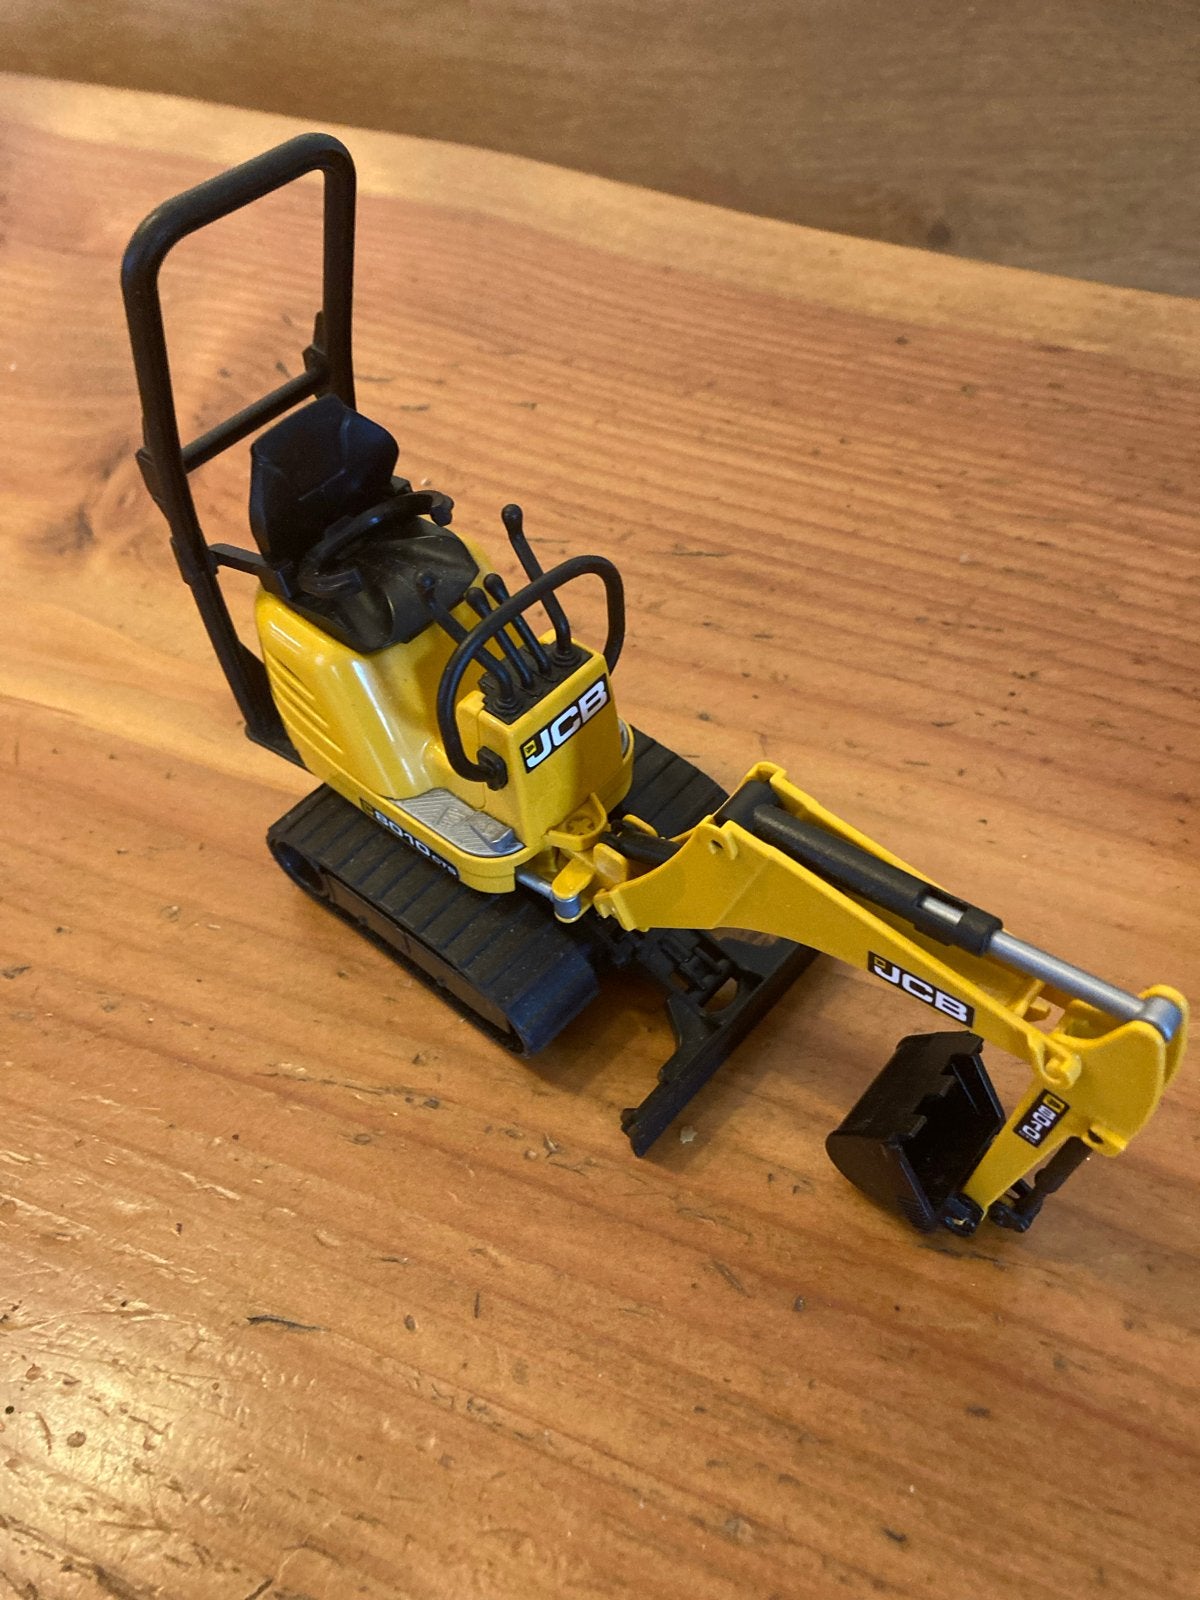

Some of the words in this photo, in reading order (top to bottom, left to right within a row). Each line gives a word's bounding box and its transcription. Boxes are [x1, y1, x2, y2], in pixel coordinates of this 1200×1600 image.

[525, 680, 608, 768] JCB
[374, 810, 431, 857] 8010
[873, 965, 968, 1022] JCB
